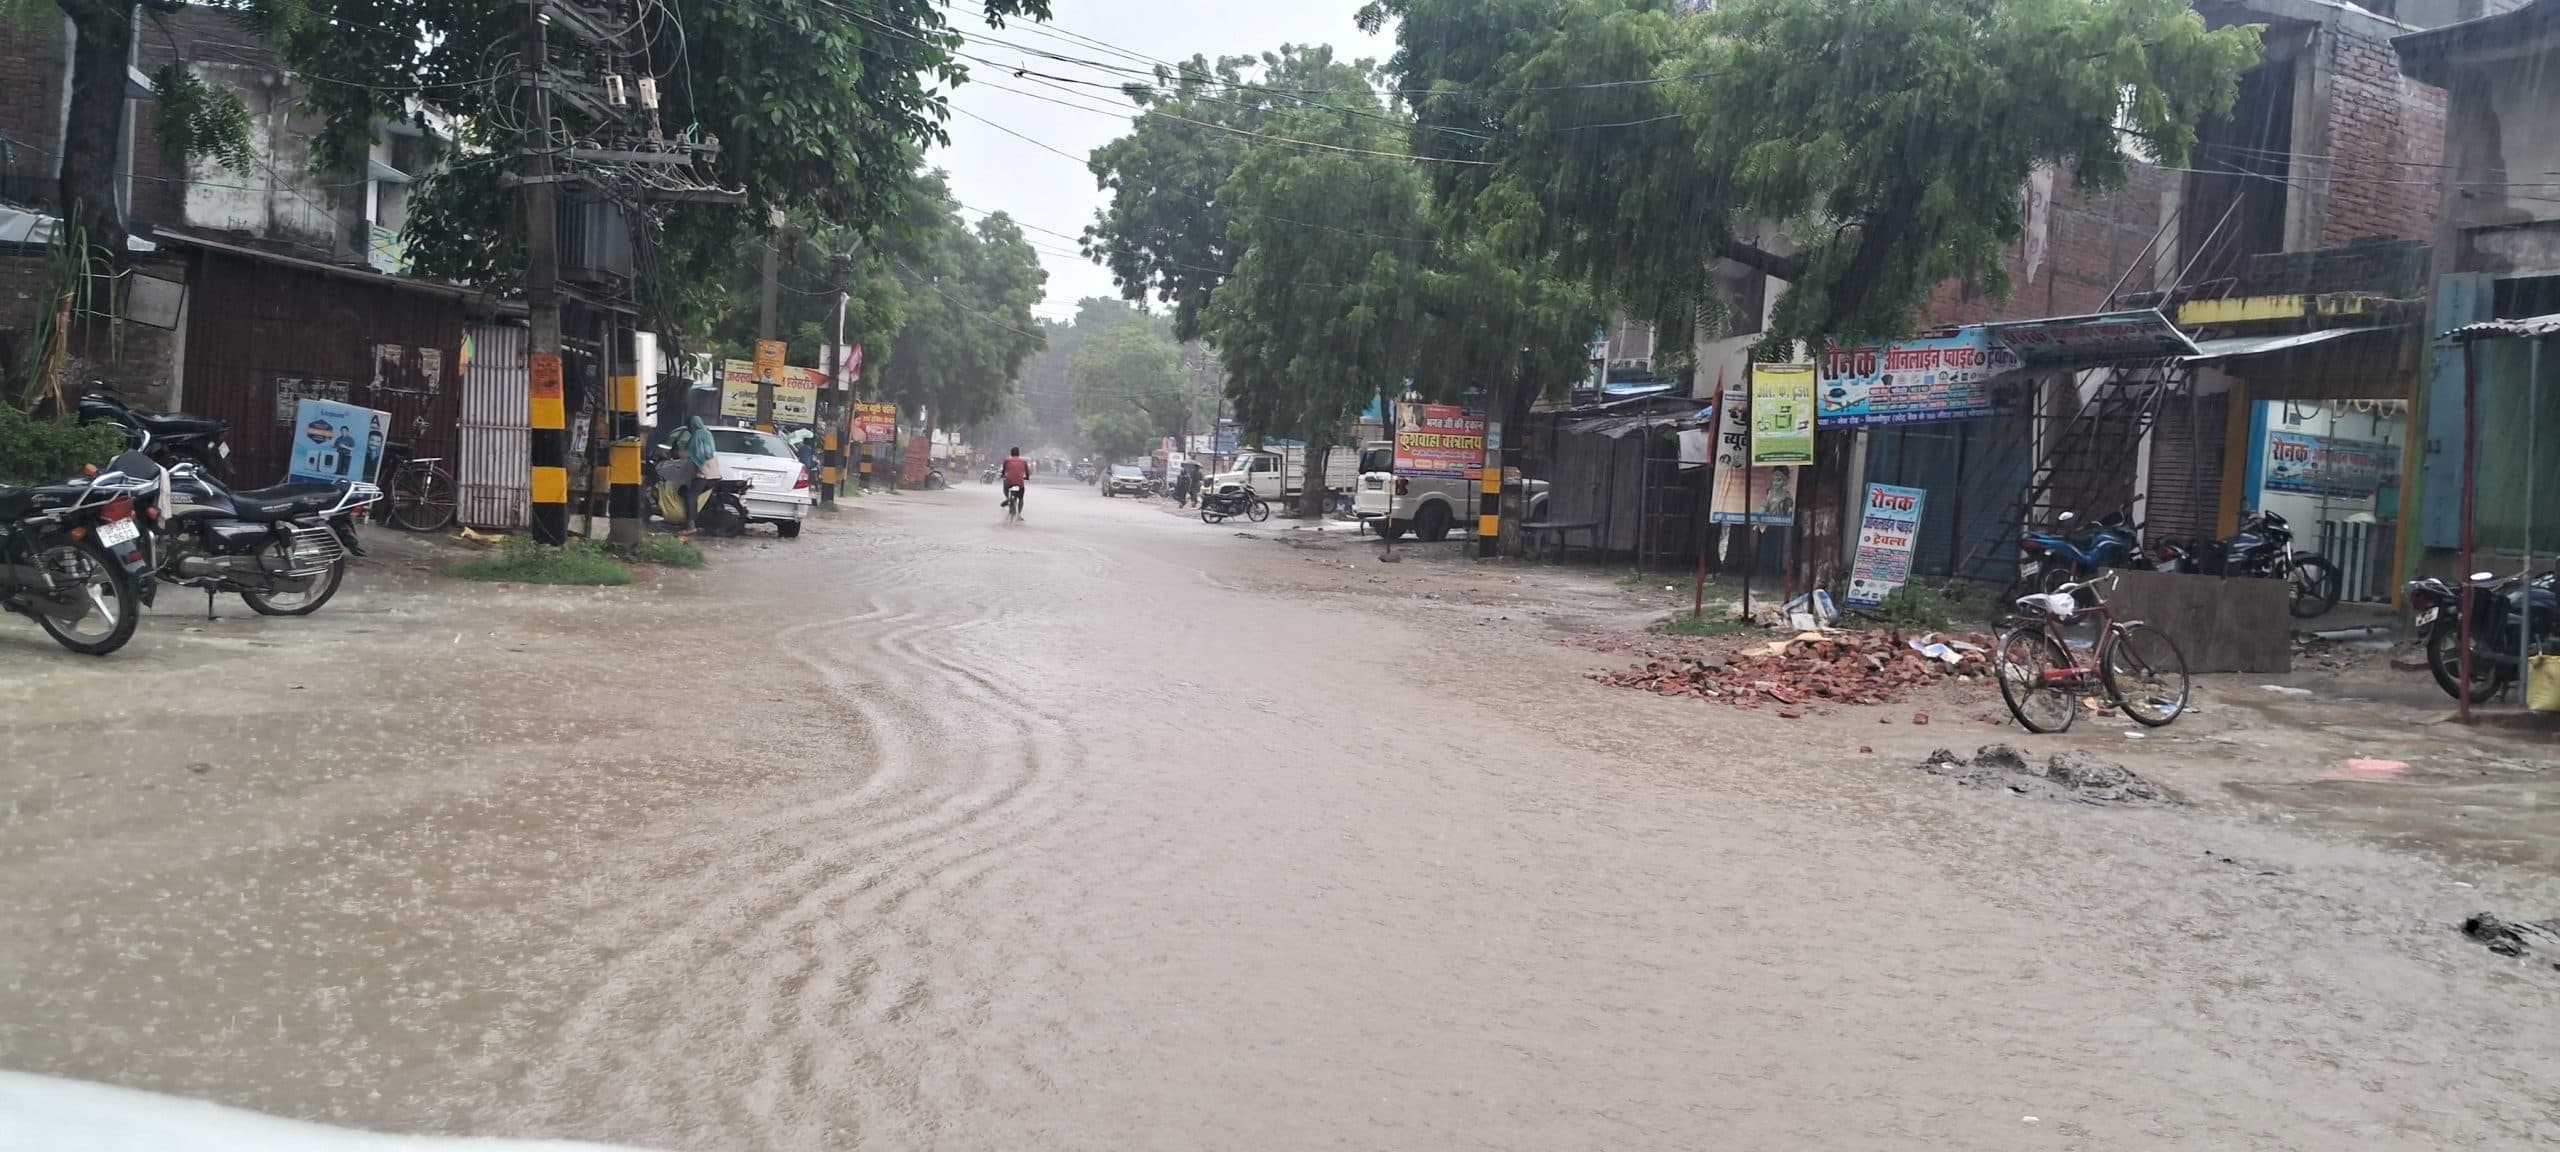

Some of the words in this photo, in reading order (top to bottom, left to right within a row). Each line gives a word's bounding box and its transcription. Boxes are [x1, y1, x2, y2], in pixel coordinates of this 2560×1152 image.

[1821, 337, 1880, 380] रौनक
[2272, 437, 2309, 462] रौनक
[1872, 487, 1915, 511] रौनक
